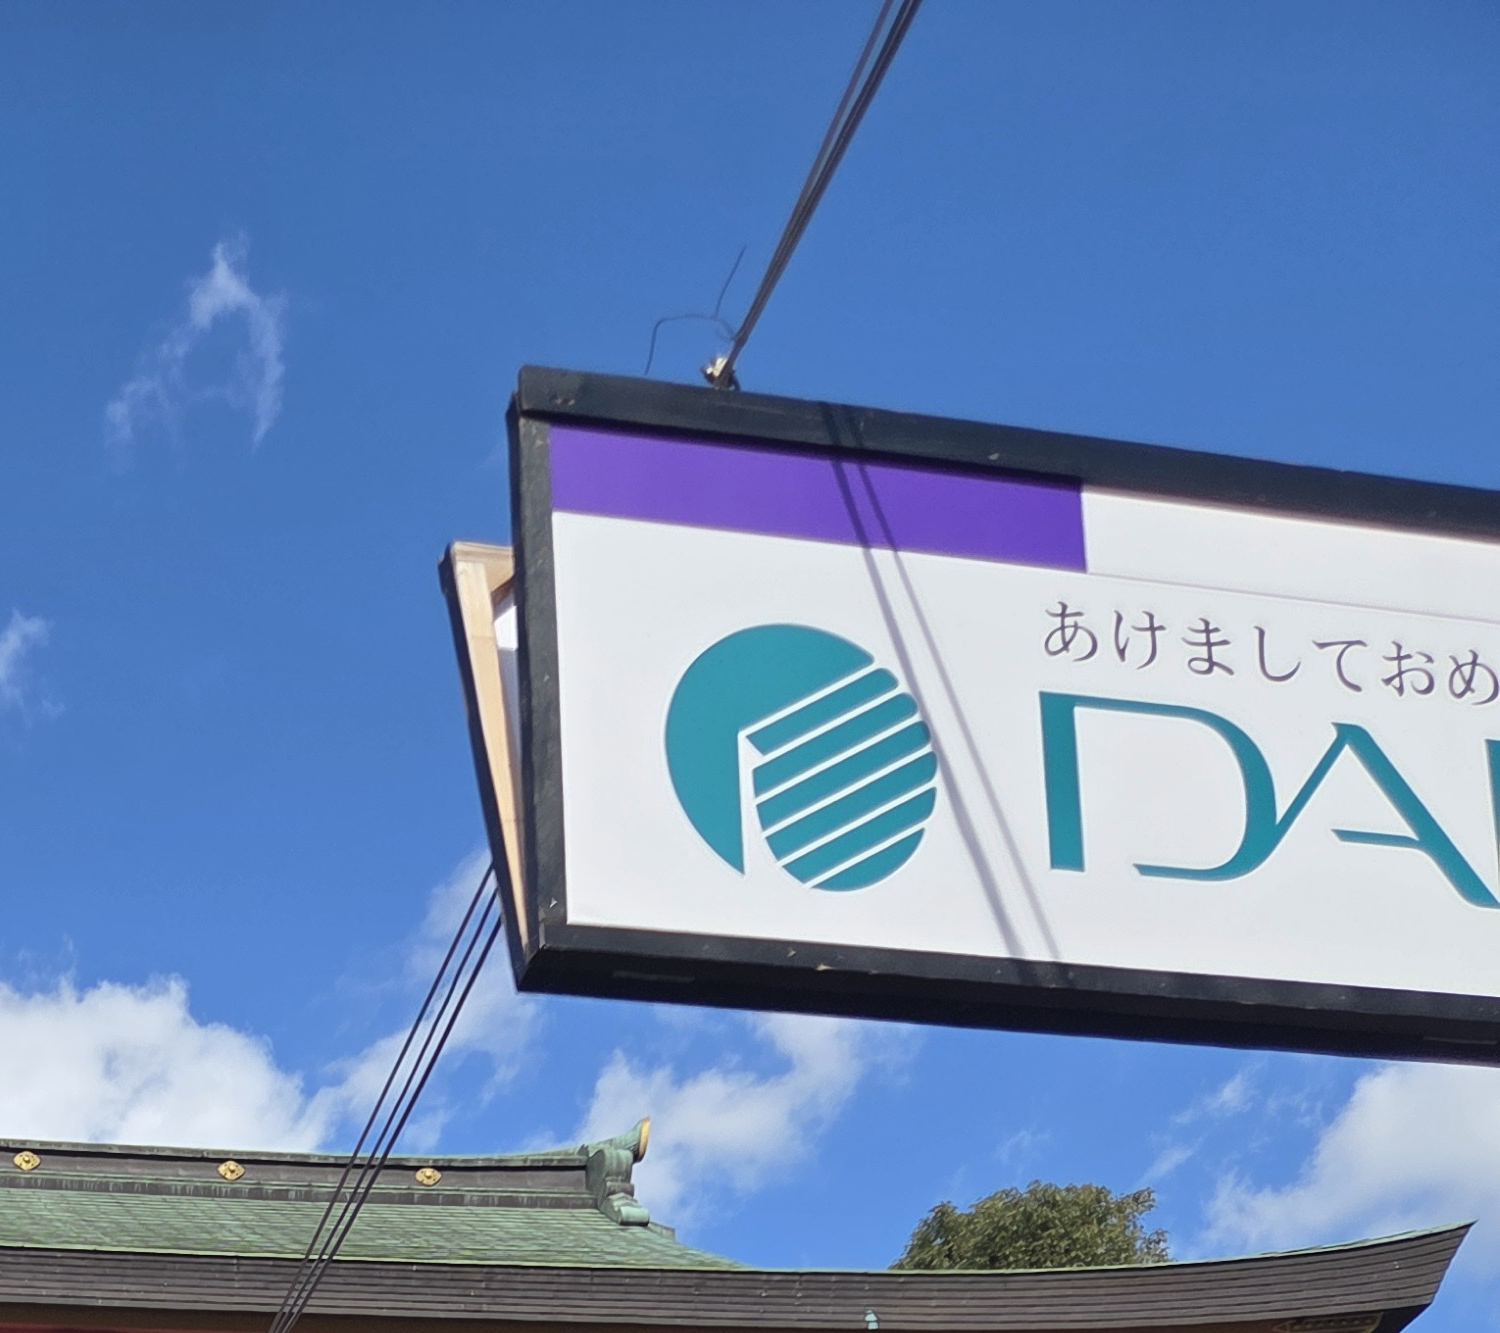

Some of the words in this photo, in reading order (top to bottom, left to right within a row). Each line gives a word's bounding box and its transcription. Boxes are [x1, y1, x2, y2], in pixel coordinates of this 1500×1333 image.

[1043, 601, 1500, 706] あけましておめ
